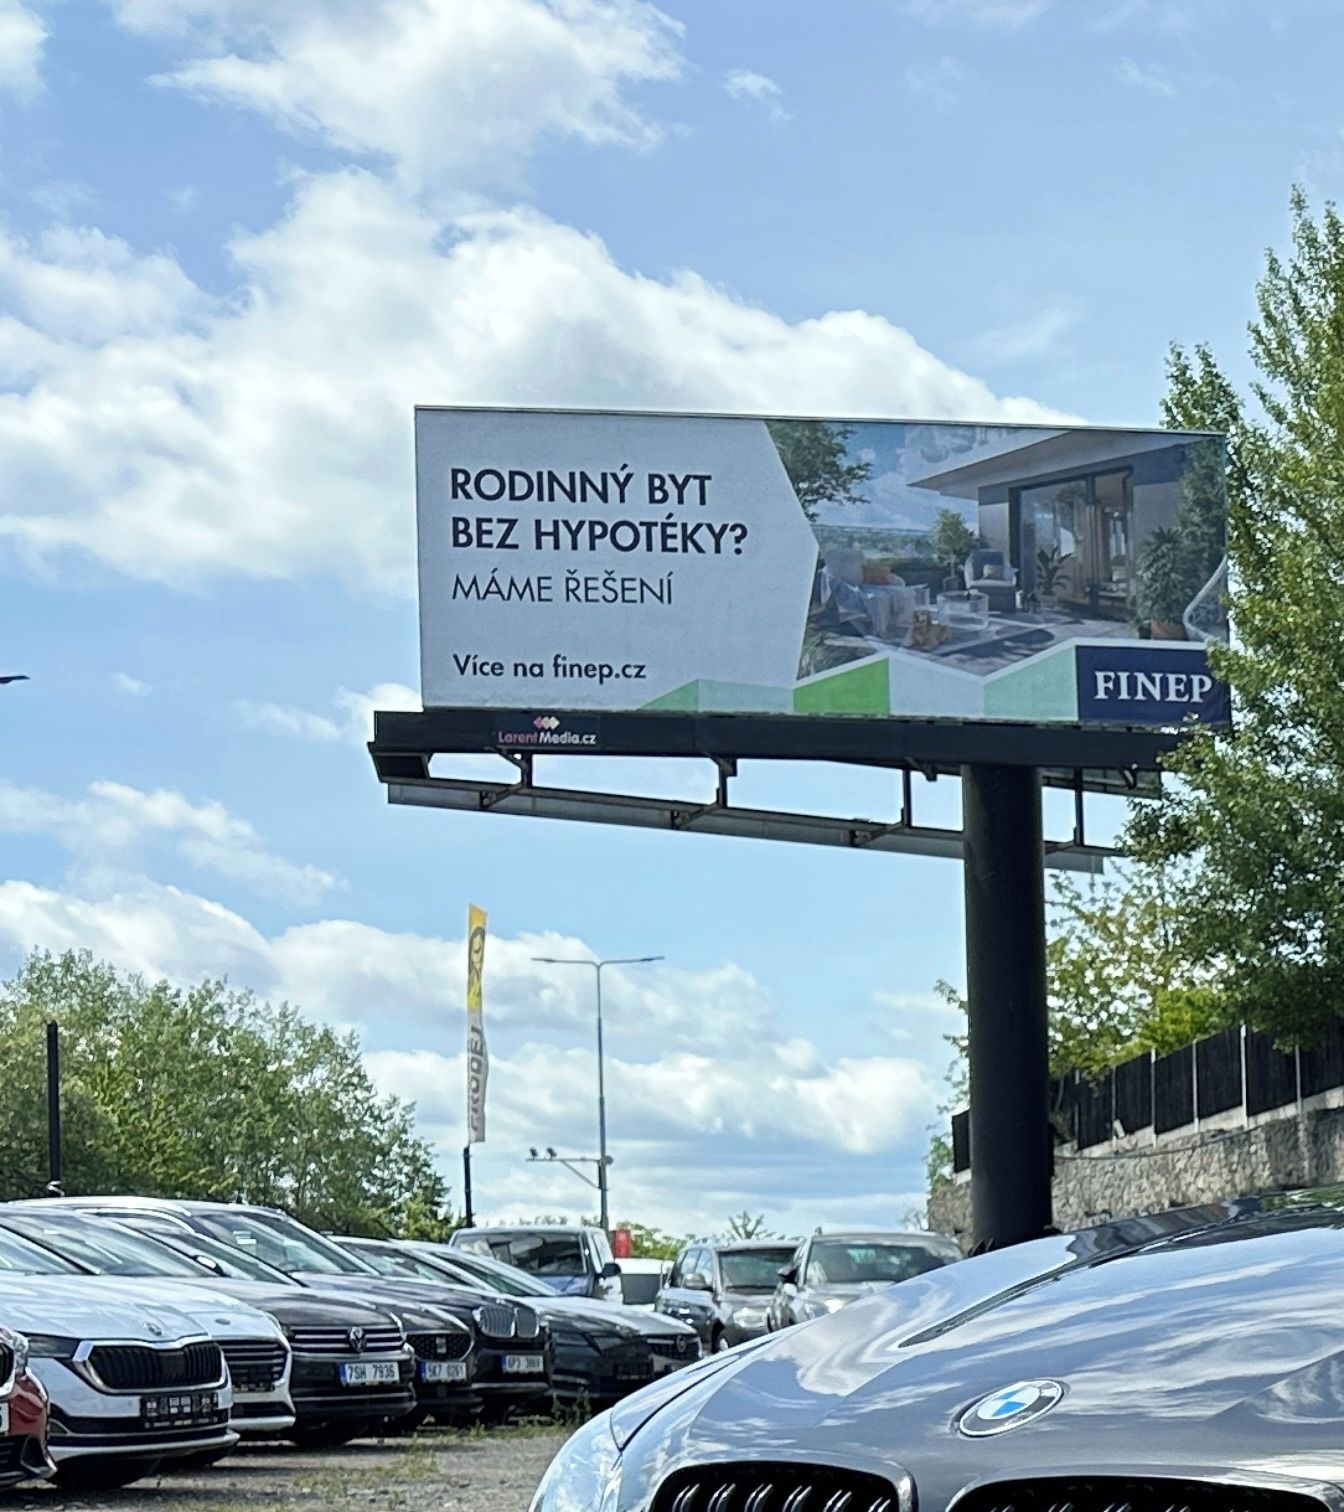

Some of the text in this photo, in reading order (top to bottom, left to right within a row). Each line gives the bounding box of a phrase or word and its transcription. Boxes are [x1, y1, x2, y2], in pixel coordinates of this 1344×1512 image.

[451, 463, 712, 506] RODINNÝ BYT
[452, 512, 748, 555] BEZ HYPOTÉKY?
[452, 567, 674, 604] MÁME ŘEŠENÍ
[453, 654, 647, 685] Více na finep.cz
[1094, 670, 1213, 703] FINEP
[498, 730, 597, 744] LarentMedia.cz
